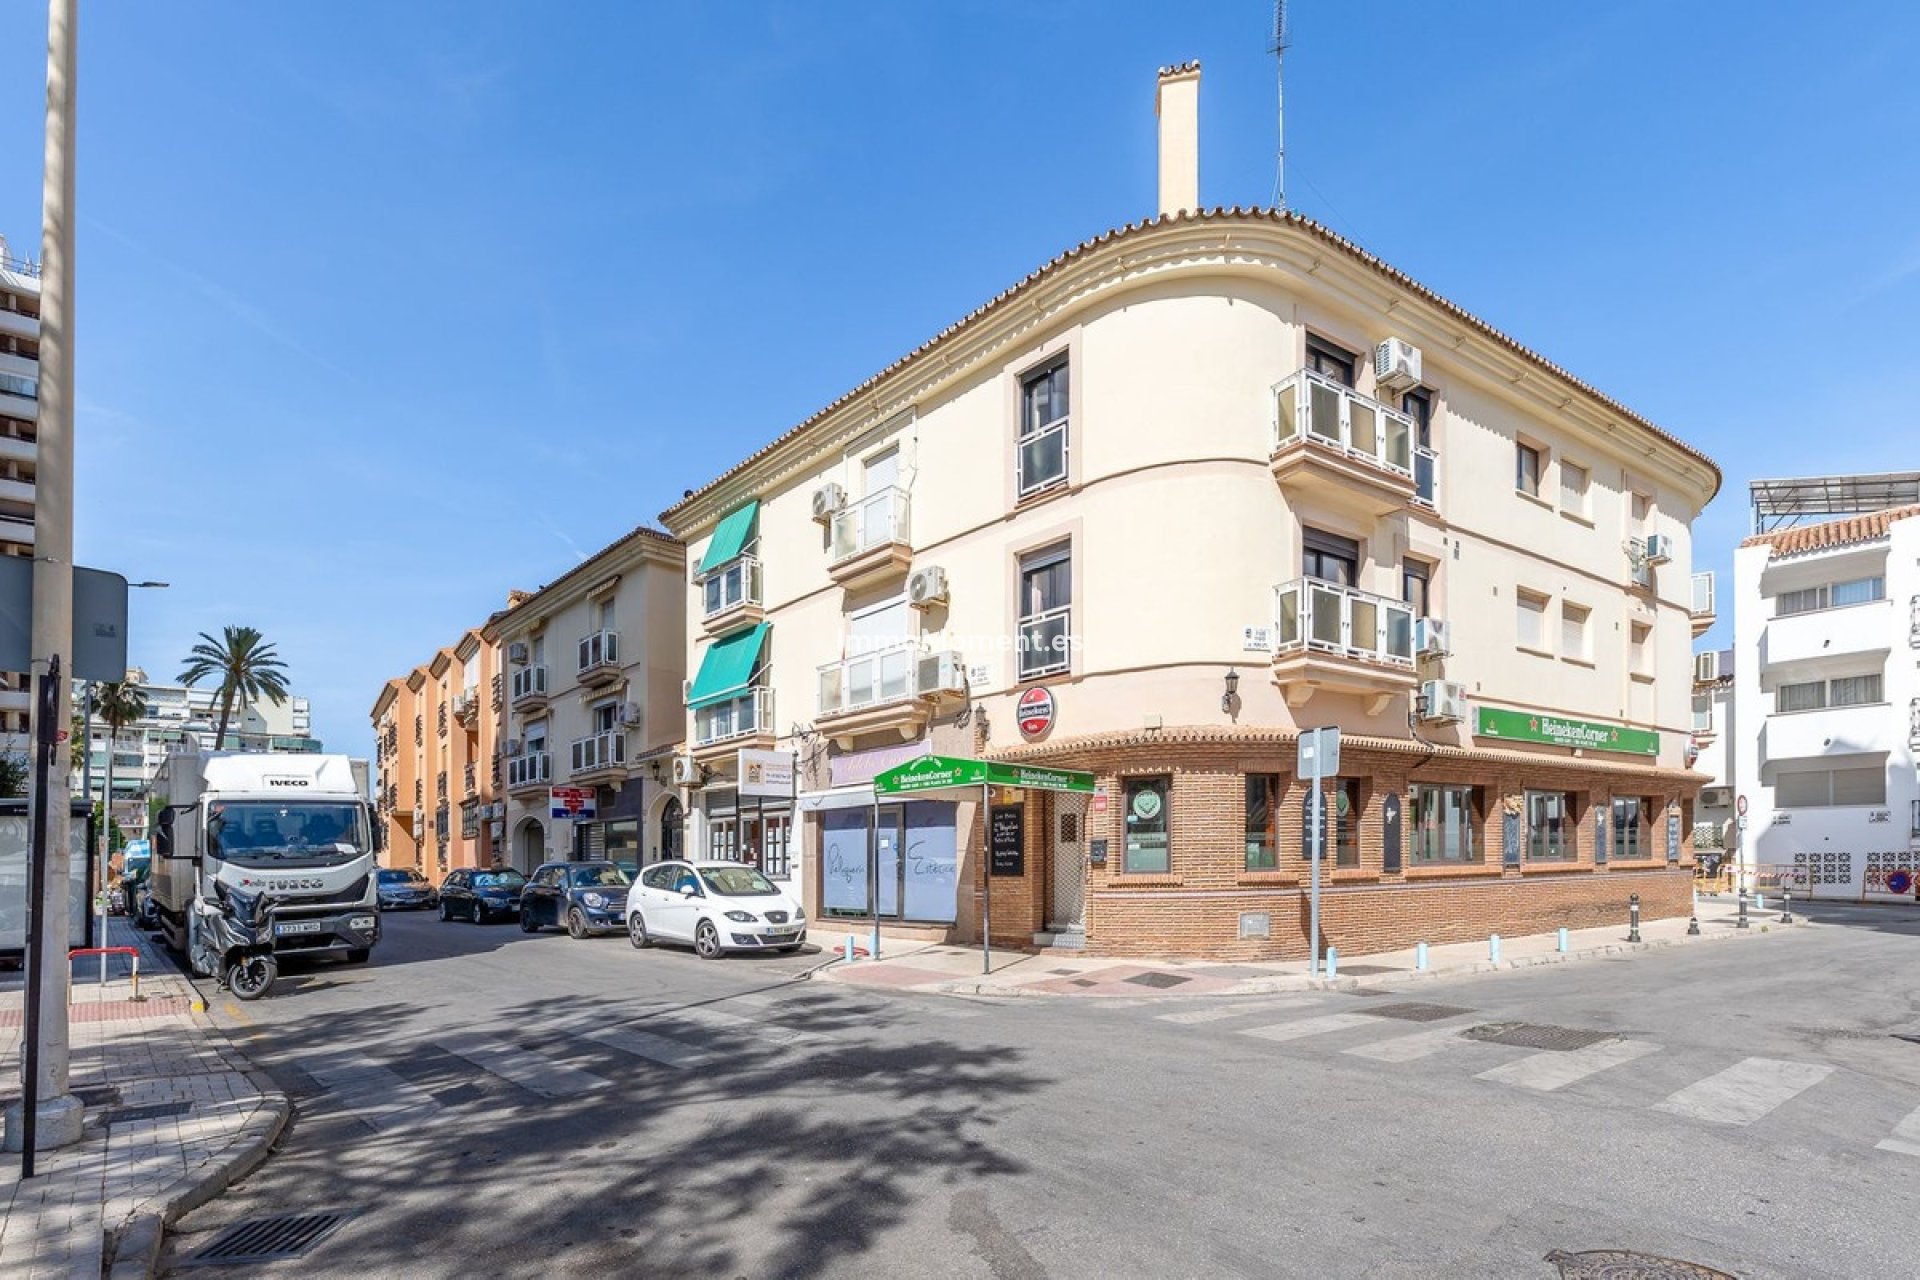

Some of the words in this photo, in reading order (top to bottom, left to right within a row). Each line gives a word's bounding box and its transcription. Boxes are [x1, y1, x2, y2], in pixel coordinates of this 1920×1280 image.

[1541, 717, 1609, 743] HeinekenCorner
[269, 779, 310, 787] IVECO
[900, 770, 953, 784] HeinekenCorner
